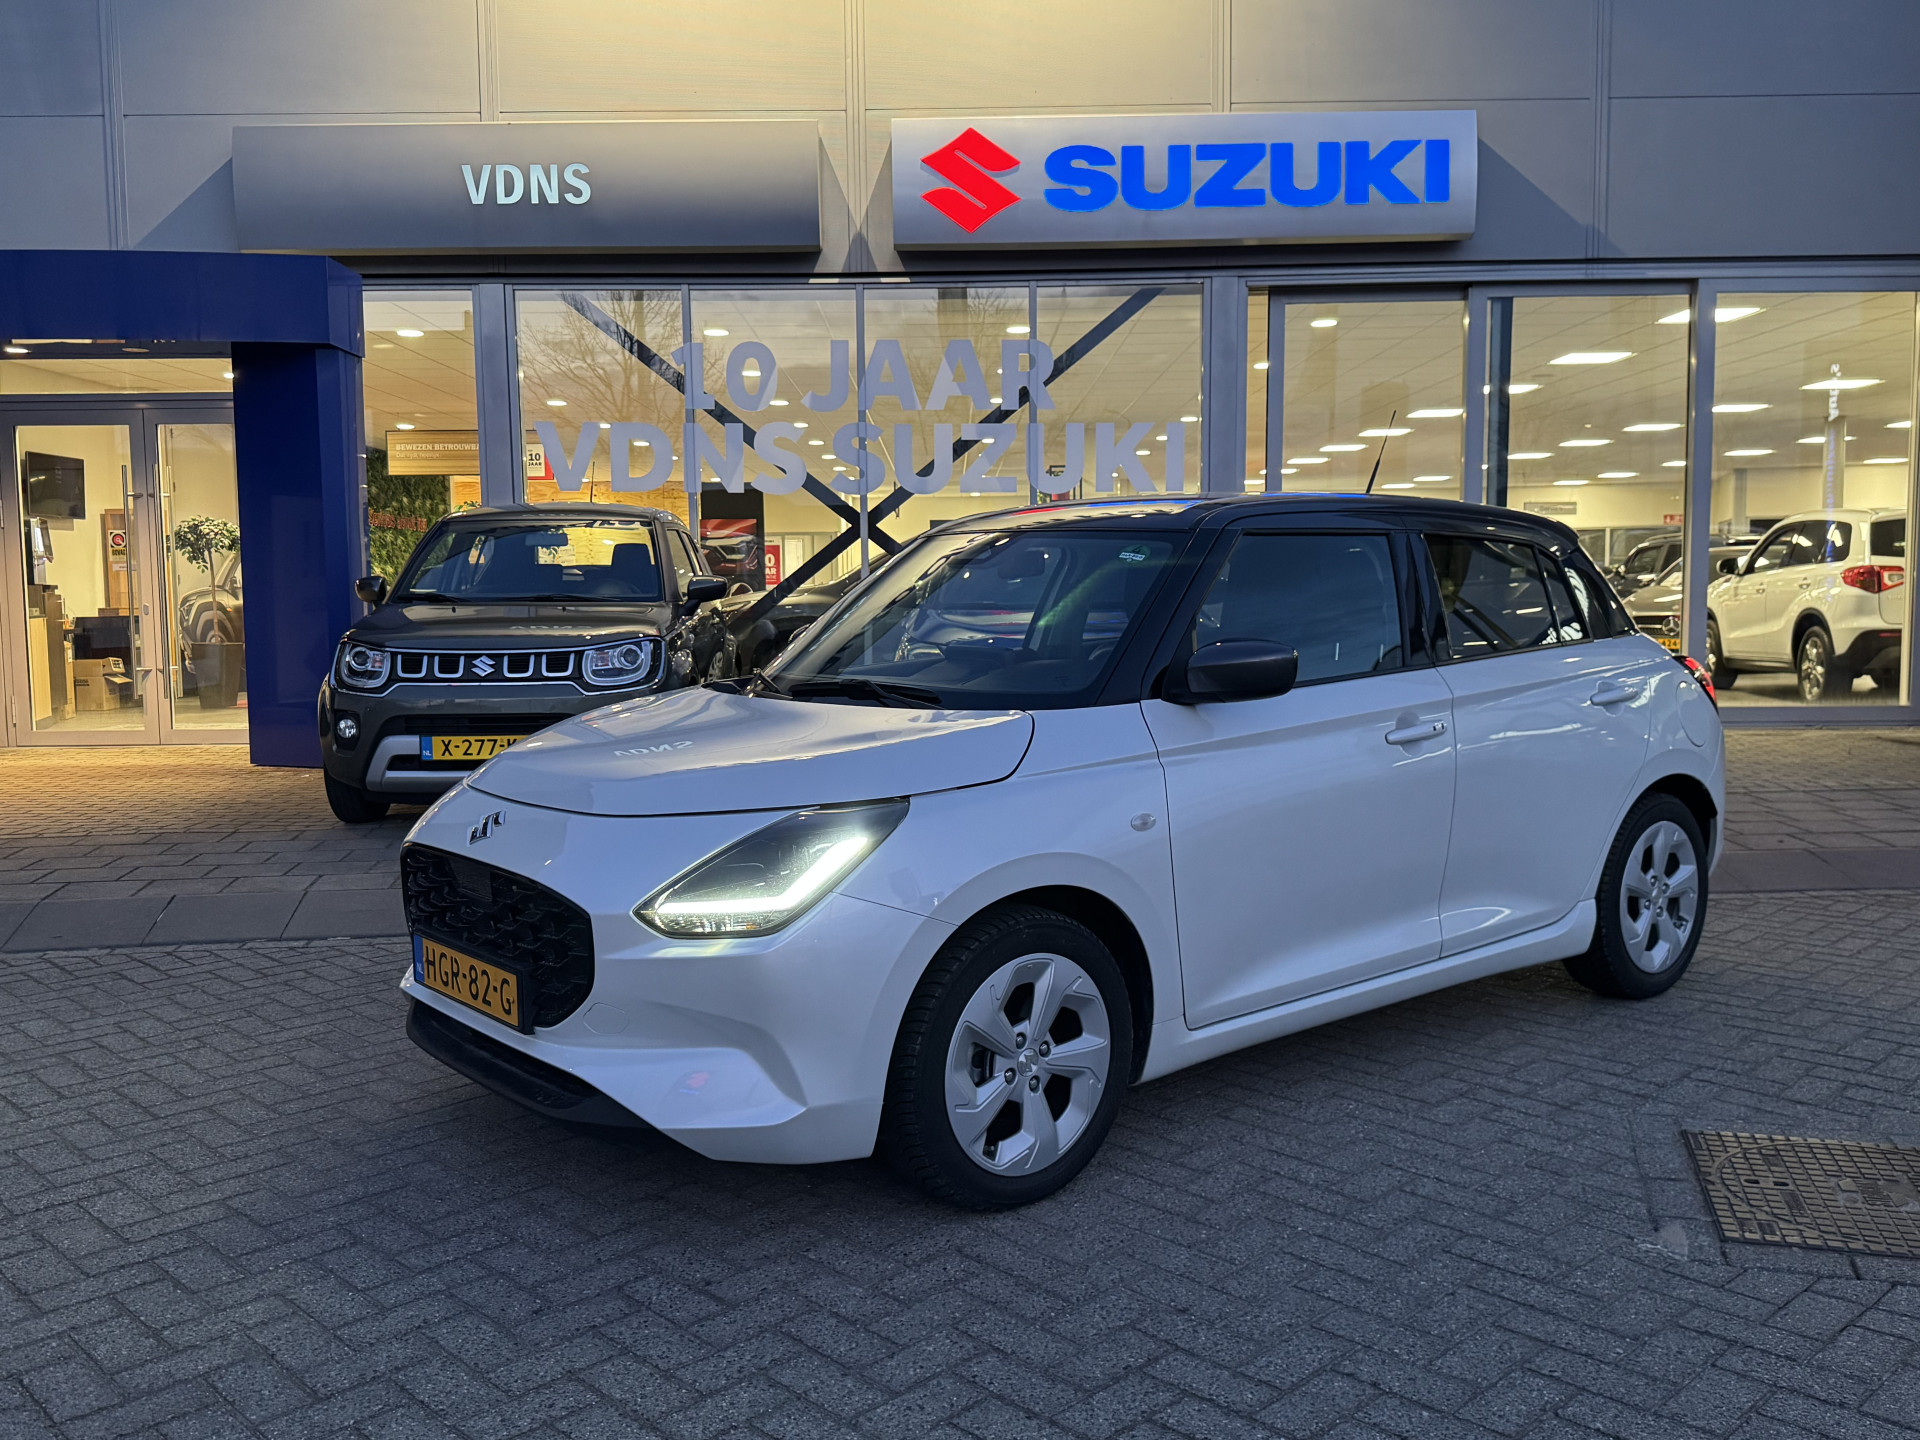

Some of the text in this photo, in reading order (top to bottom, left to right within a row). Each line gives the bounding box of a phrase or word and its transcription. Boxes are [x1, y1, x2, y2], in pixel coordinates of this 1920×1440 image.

[461, 163, 592, 205] VDNS
[1044, 139, 1450, 212] SUZUKI
[671, 339, 1056, 413] 10 JAAR
[395, 443, 433, 451] BEWEZEN
[528, 453, 541, 461] 10
[534, 421, 1185, 495] VDNS SUZUKI
[425, 945, 515, 1015] HGR-82-G
